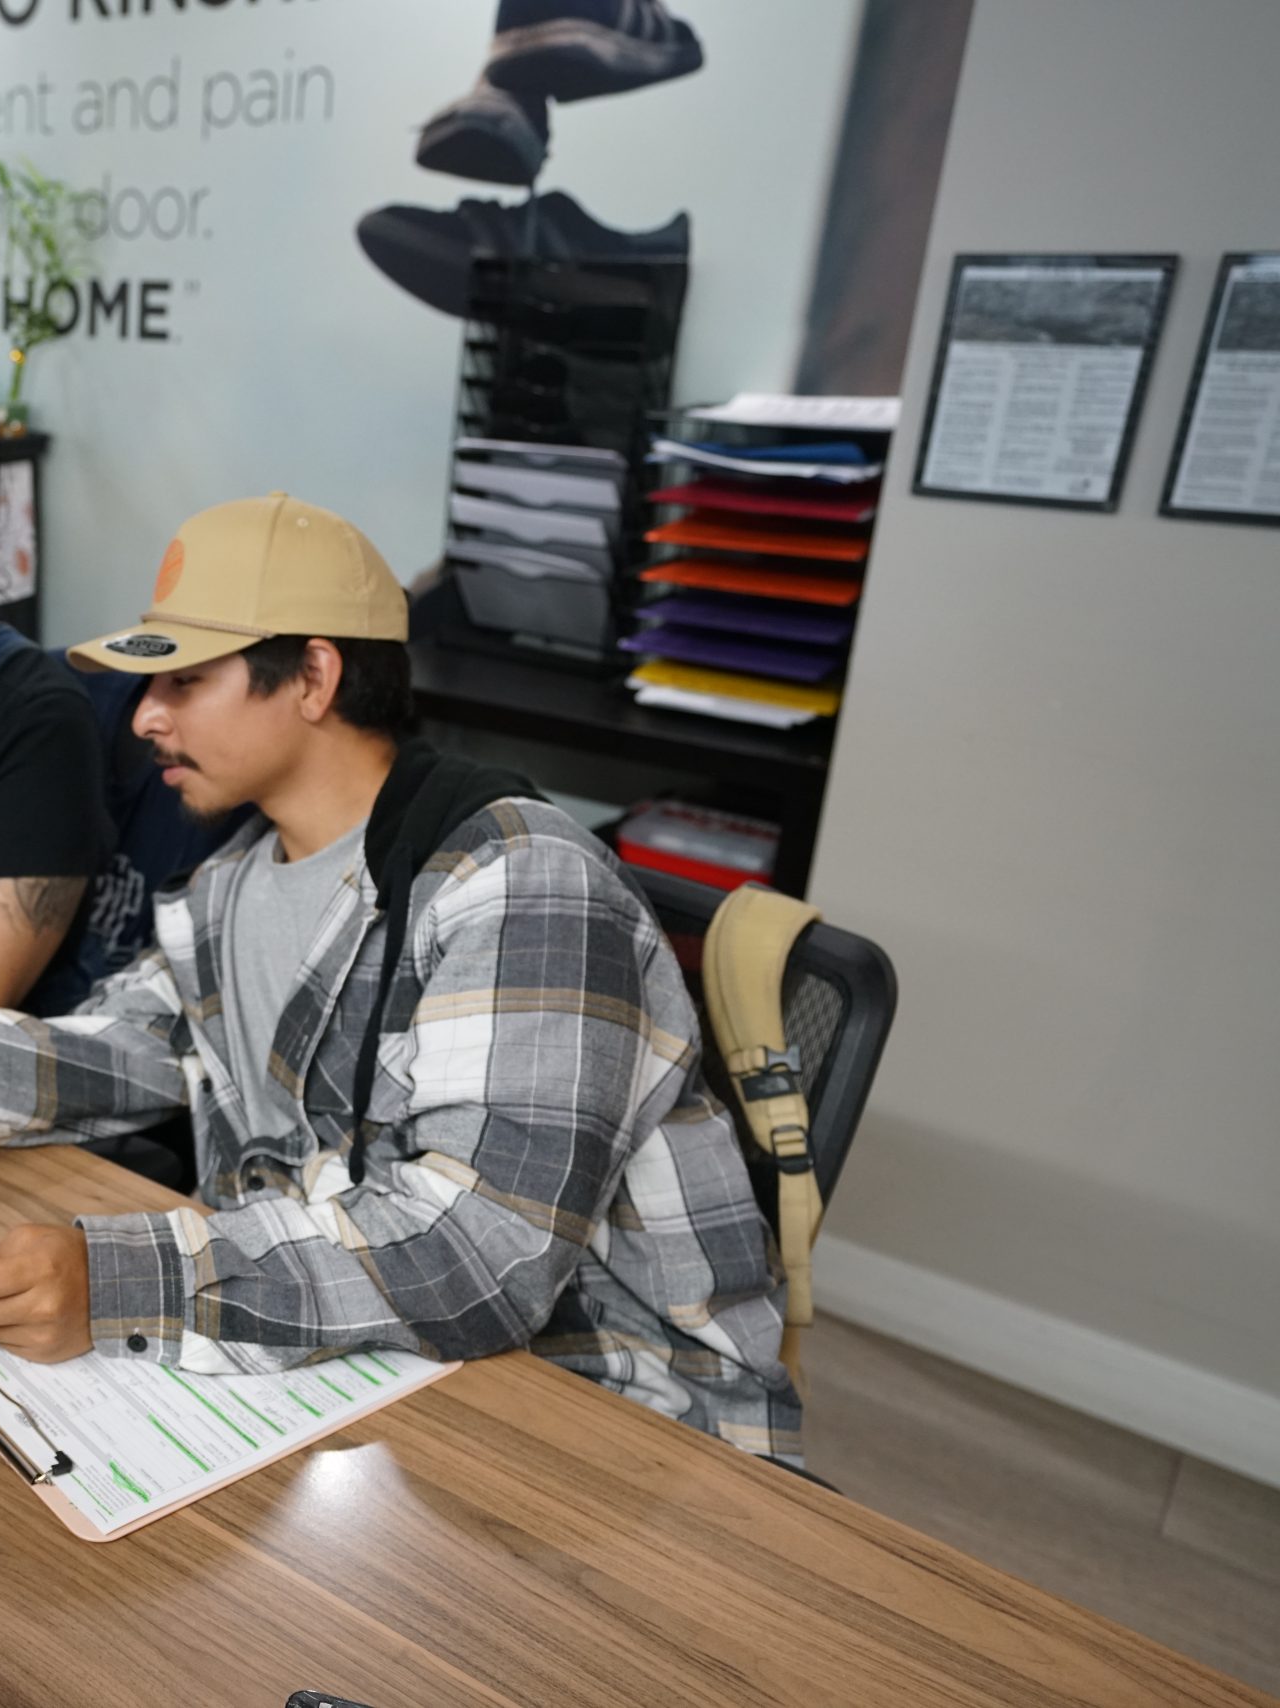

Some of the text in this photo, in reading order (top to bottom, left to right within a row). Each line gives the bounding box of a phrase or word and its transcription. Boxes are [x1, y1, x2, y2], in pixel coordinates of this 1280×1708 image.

[72, 54, 181, 135] and
[200, 48, 335, 142] pain
[72, 170, 214, 241] door.
